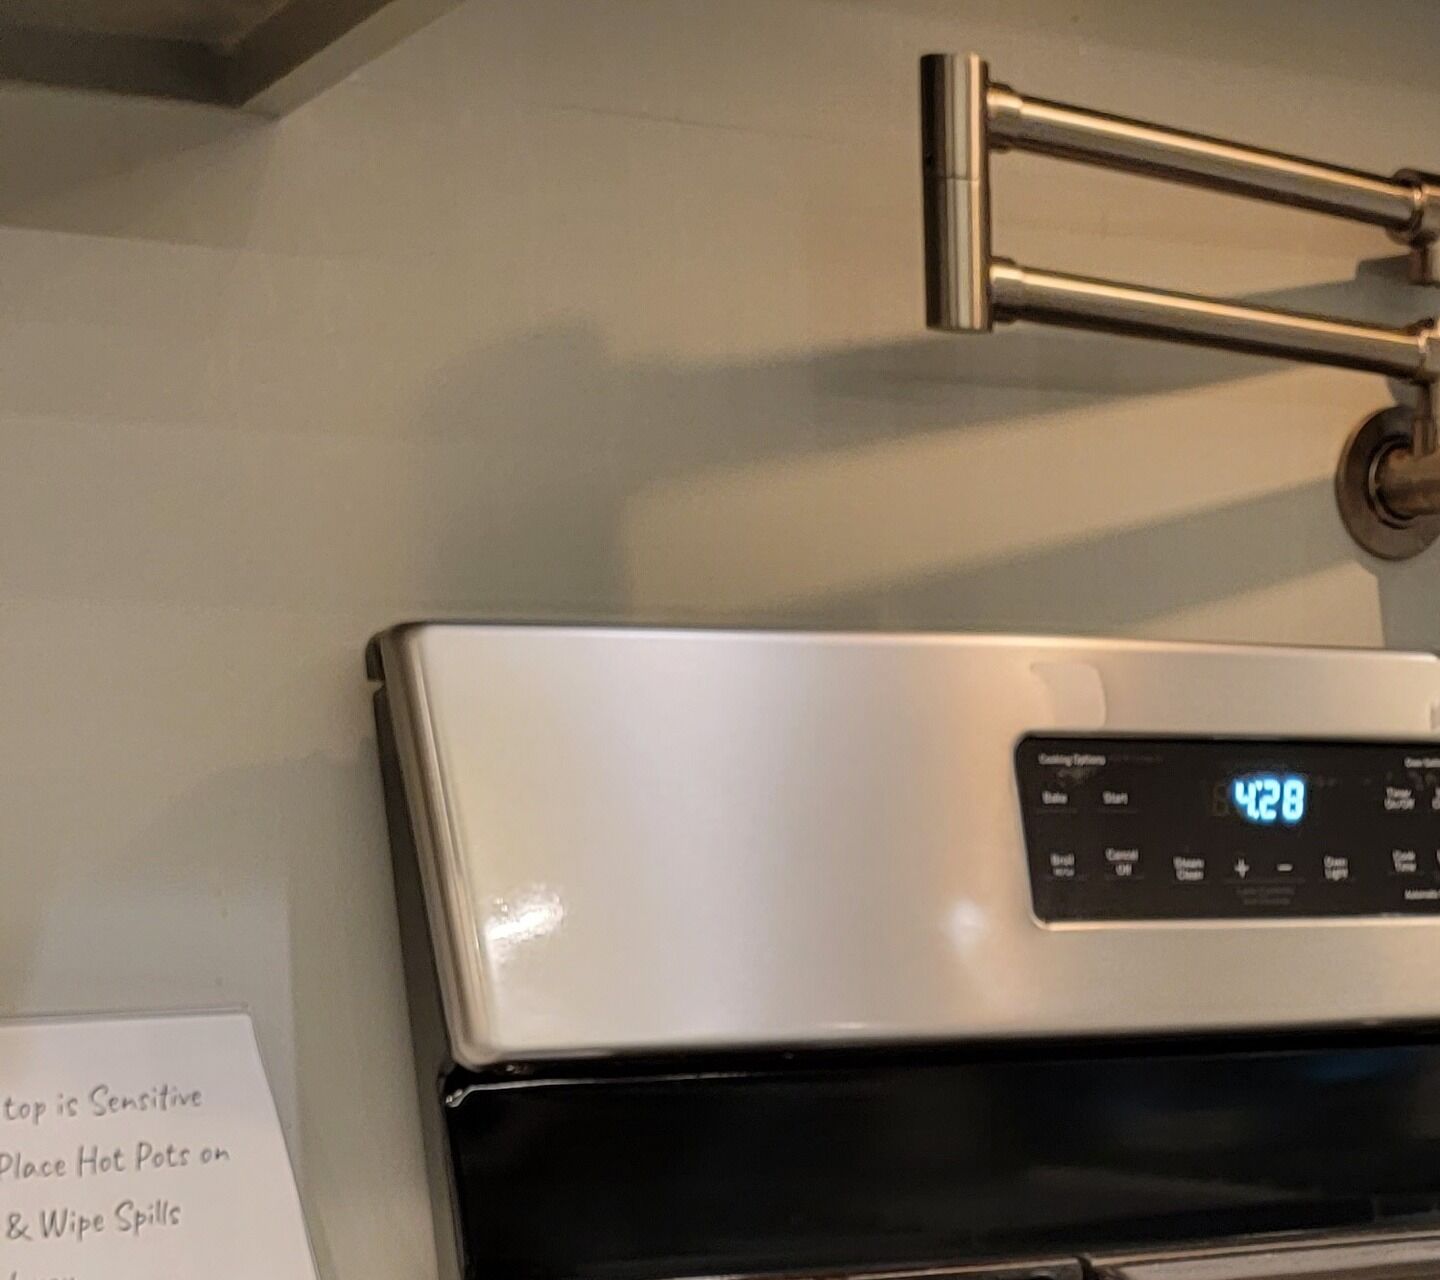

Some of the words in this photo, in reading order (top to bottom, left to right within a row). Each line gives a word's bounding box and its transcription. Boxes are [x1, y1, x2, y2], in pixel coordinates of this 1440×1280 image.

[1235, 779, 1305, 820] 4:28
[4, 1096, 47, 1126] top
[57, 1093, 79, 1117] is
[90, 1083, 203, 1117] Sensitive
[0, 1152, 67, 1182] Place
[78, 1144, 126, 1178] Hot
[137, 1141, 191, 1172] Pots
[200, 1147, 231, 1165] on
[6, 1212, 34, 1241] &
[40, 1208, 105, 1242] Wipe
[115, 1199, 182, 1237] Spills
